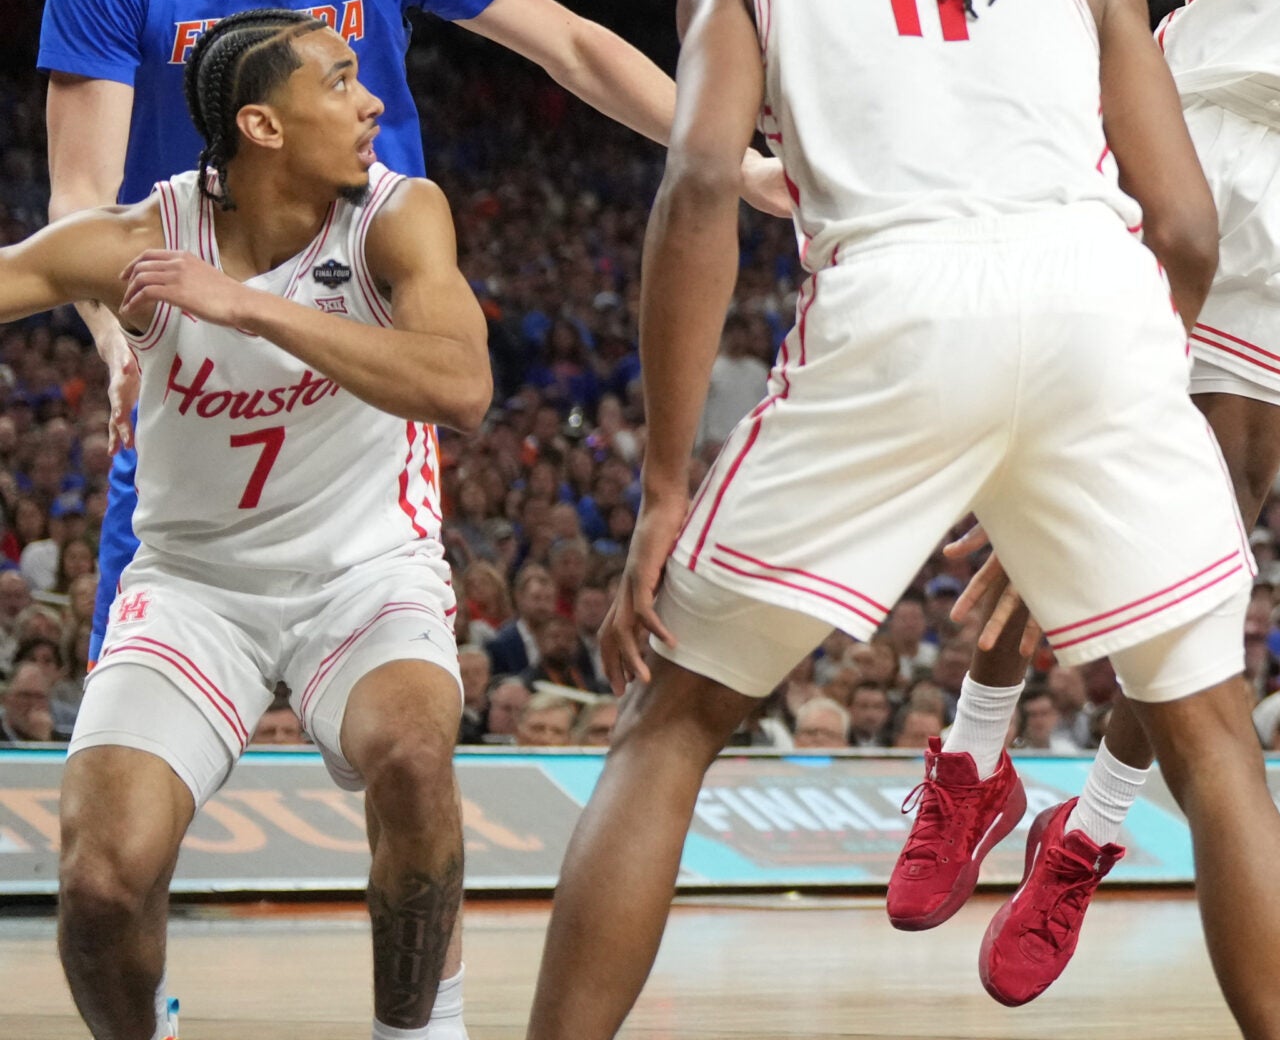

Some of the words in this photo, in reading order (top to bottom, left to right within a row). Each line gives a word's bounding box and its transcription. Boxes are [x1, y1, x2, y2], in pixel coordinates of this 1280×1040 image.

[315, 269, 332, 278] FINAL
[333, 269, 350, 278] FOUR
[230, 426, 285, 509] 7
[693, 786, 907, 832] FINAL
